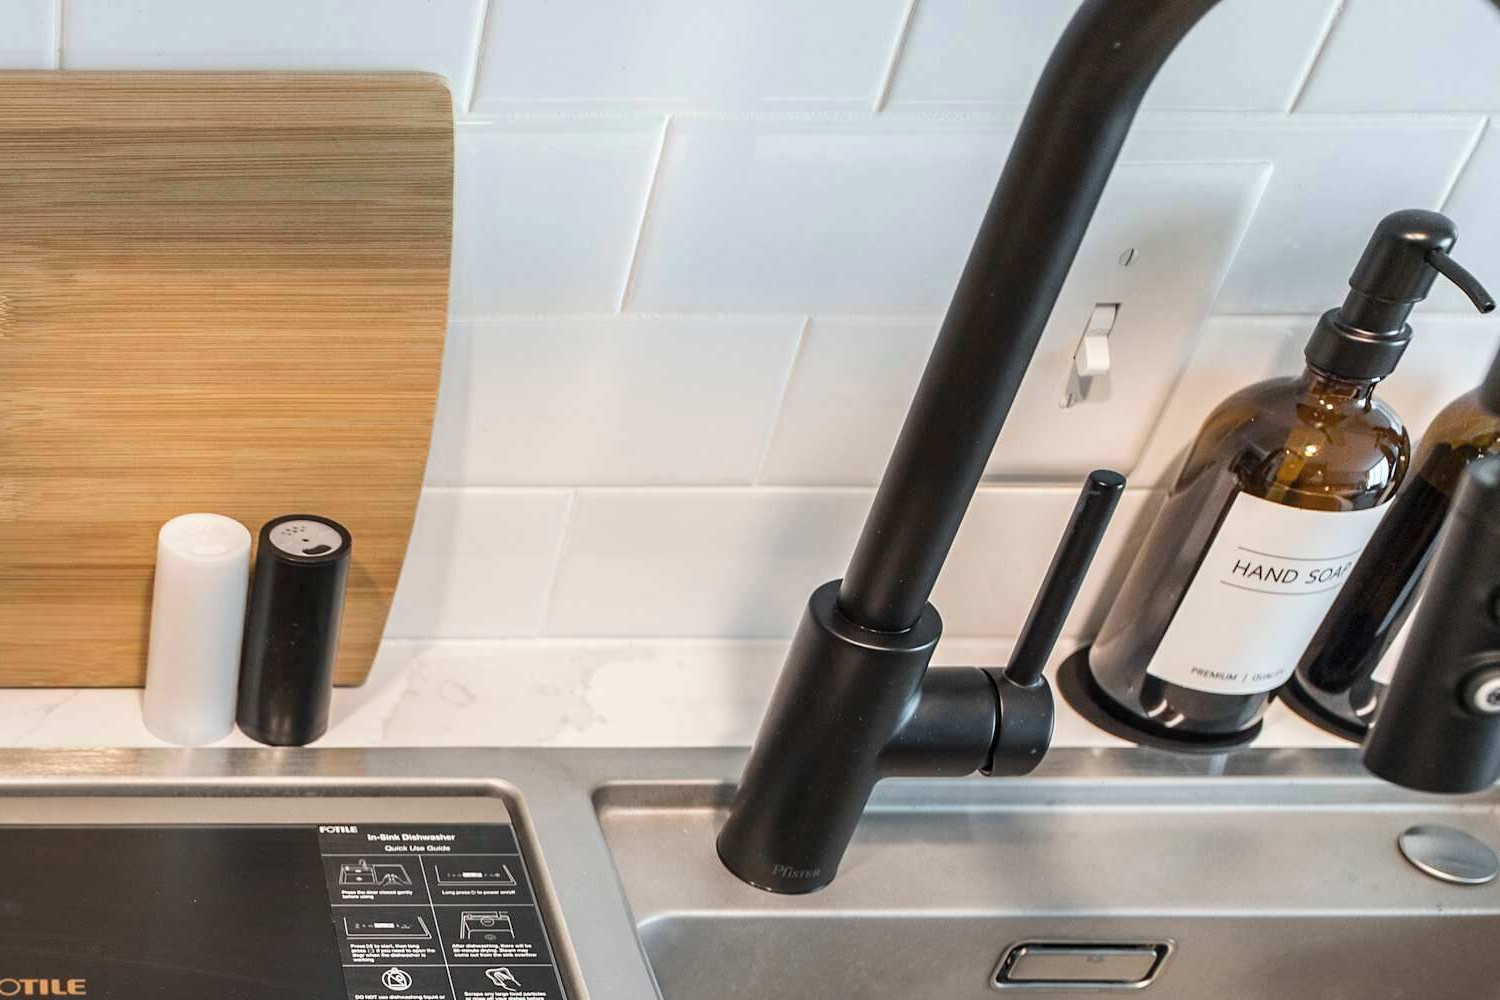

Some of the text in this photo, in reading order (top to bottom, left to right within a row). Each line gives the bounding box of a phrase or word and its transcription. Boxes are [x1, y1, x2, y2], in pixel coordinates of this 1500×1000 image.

[1232, 559, 1299, 585] HAND
[1191, 667, 1238, 680] PREMIUM
[367, 833, 455, 841] In-Sink Dishwasher
